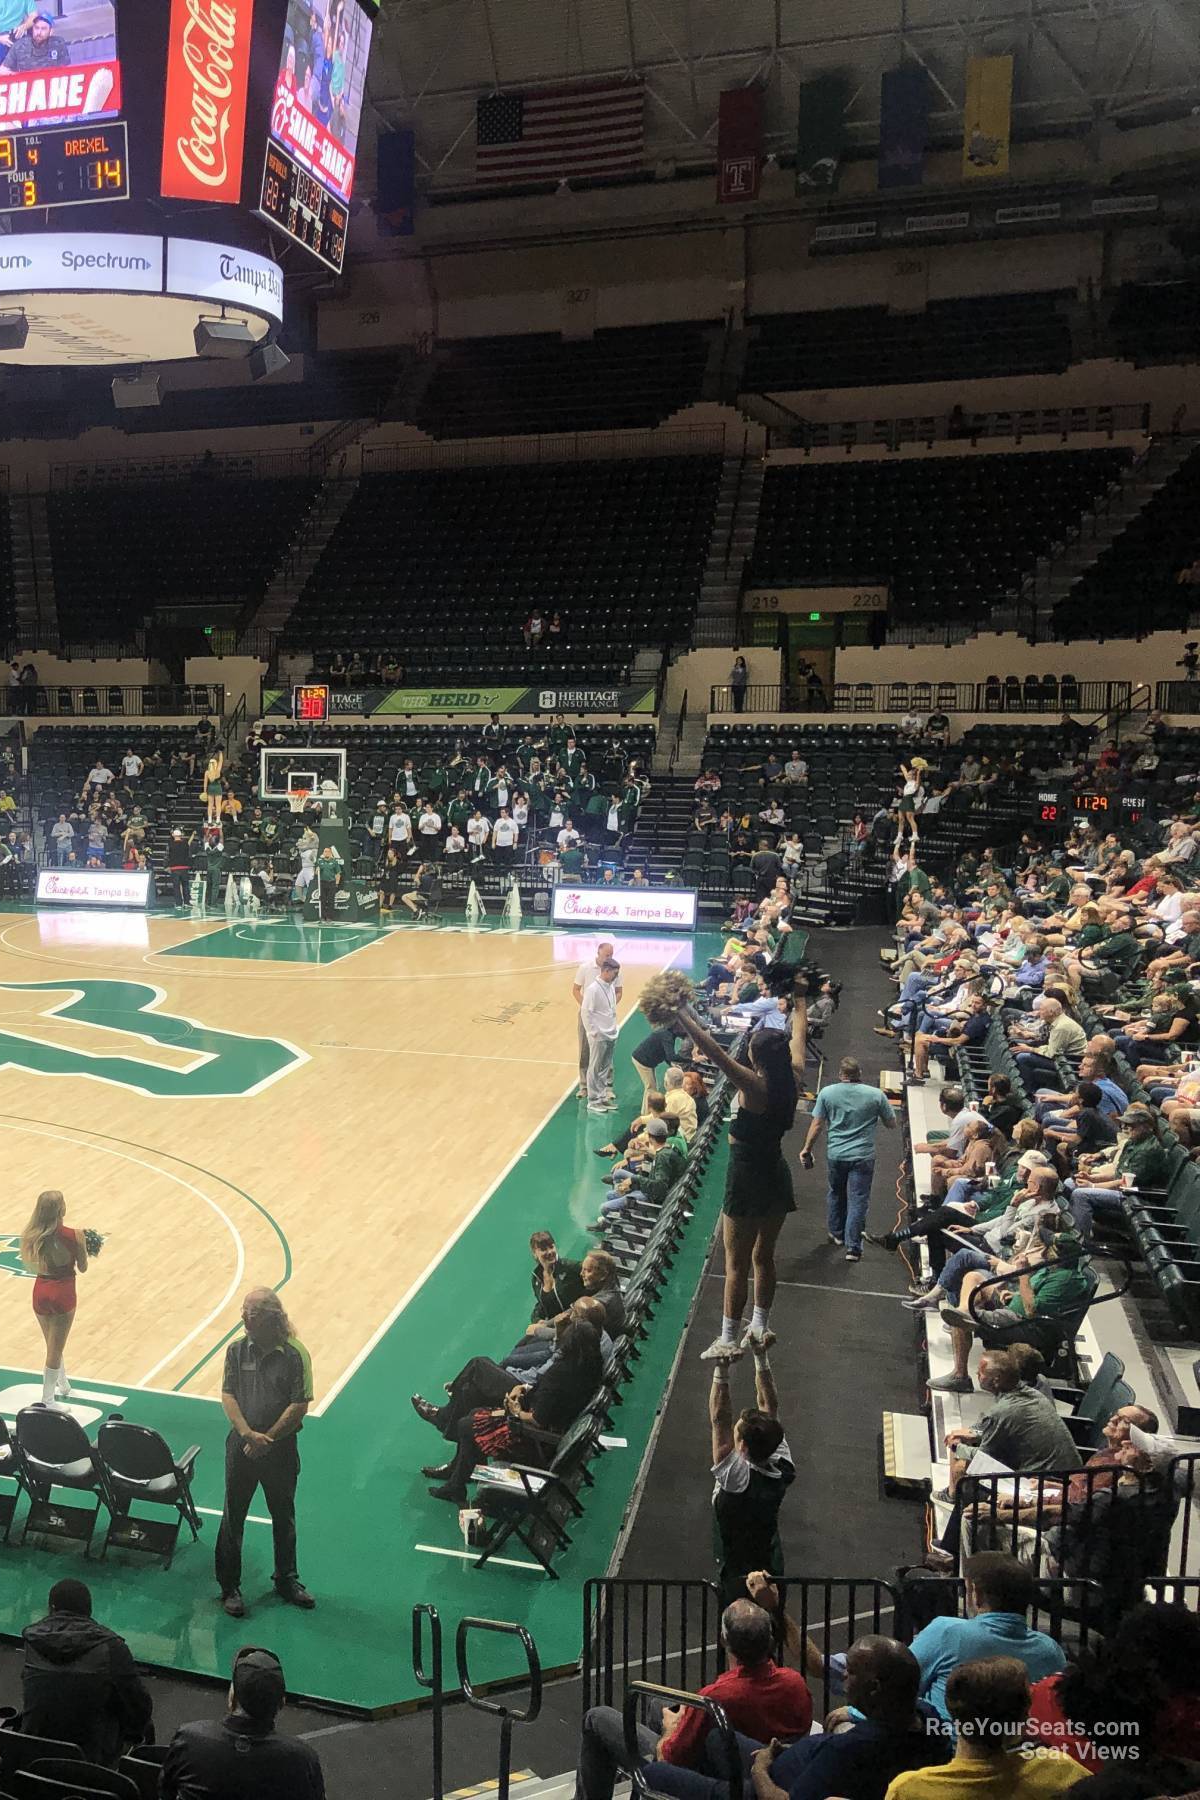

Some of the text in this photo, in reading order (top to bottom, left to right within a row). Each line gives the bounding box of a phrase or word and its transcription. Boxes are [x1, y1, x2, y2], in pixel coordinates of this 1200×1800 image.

[177, 0, 236, 187] Coca-Cola
[65, 137, 109, 157] DREXEL
[28, 149, 38, 165] 4
[8, 171, 35, 183] FOULS
[96, 159, 121, 189] 14
[24, 181, 37, 206] 3
[62, 250, 147, 272] Spectrum
[220, 253, 267, 297] Tampa
[752, 594, 882, 609] 219 220
[301, 687, 326, 699] 11:29
[331, 694, 363, 703] ITAGE
[428, 692, 482, 707] HERD
[558, 691, 619, 701] HERITAGE
[558, 700, 619, 709] INSURANCE
[1039, 792, 1058, 802] HOME
[1076, 796, 1108, 811] 11:29
[1042, 806, 1057, 820] 22
[94, 888, 122, 898] Tampa
[625, 906, 661, 919] Tampa
[665, 908, 685, 920] Bay
